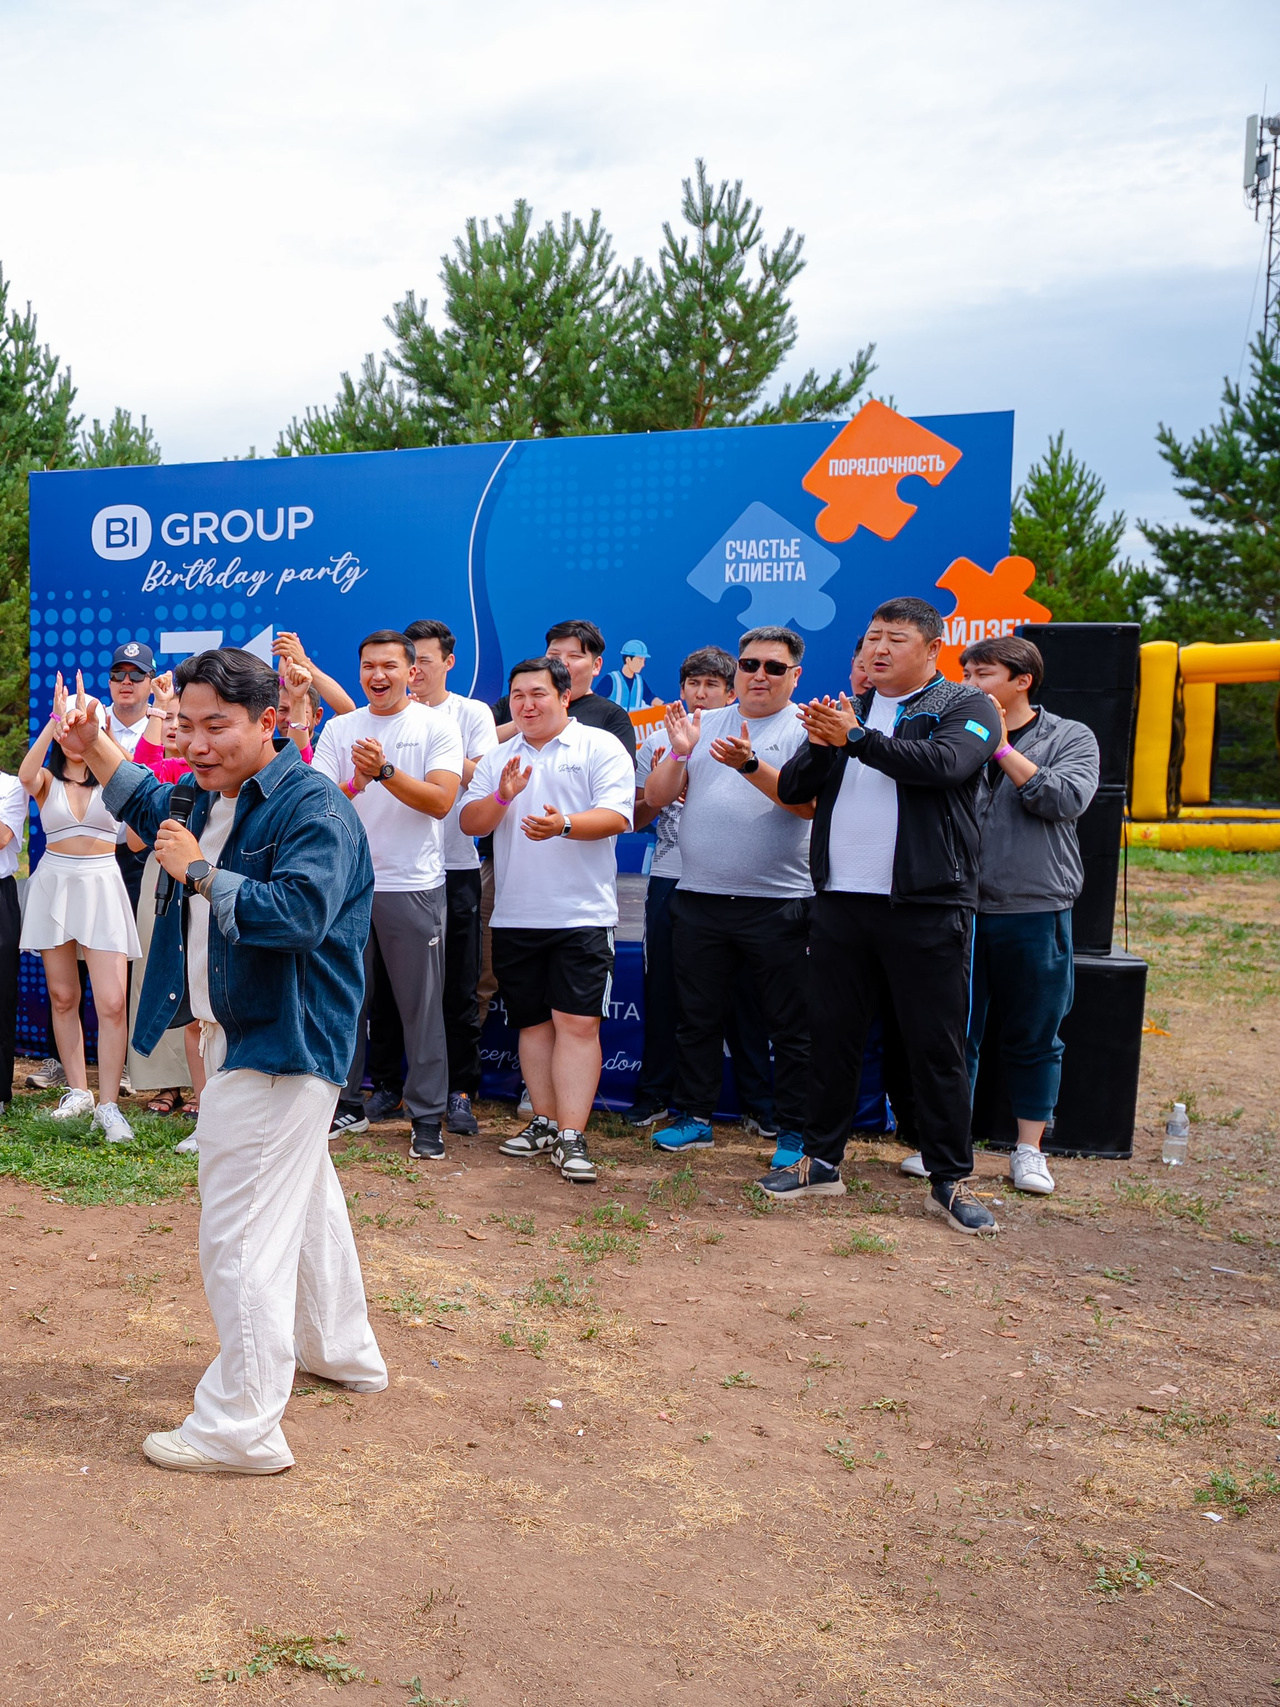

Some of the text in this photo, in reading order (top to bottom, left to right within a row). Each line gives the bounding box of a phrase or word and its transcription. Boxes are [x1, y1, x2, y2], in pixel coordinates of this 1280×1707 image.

[828, 455, 946, 476] ПОРЯДОЧНОСТЬ
[106, 505, 314, 548] BI GROUP
[725, 538, 801, 560] СЧАСТЬЕ
[141, 551, 369, 597] Birthday party
[725, 561, 807, 583] КЛИЕНТА
[941, 616, 1031, 648] АЙДЗЕ
